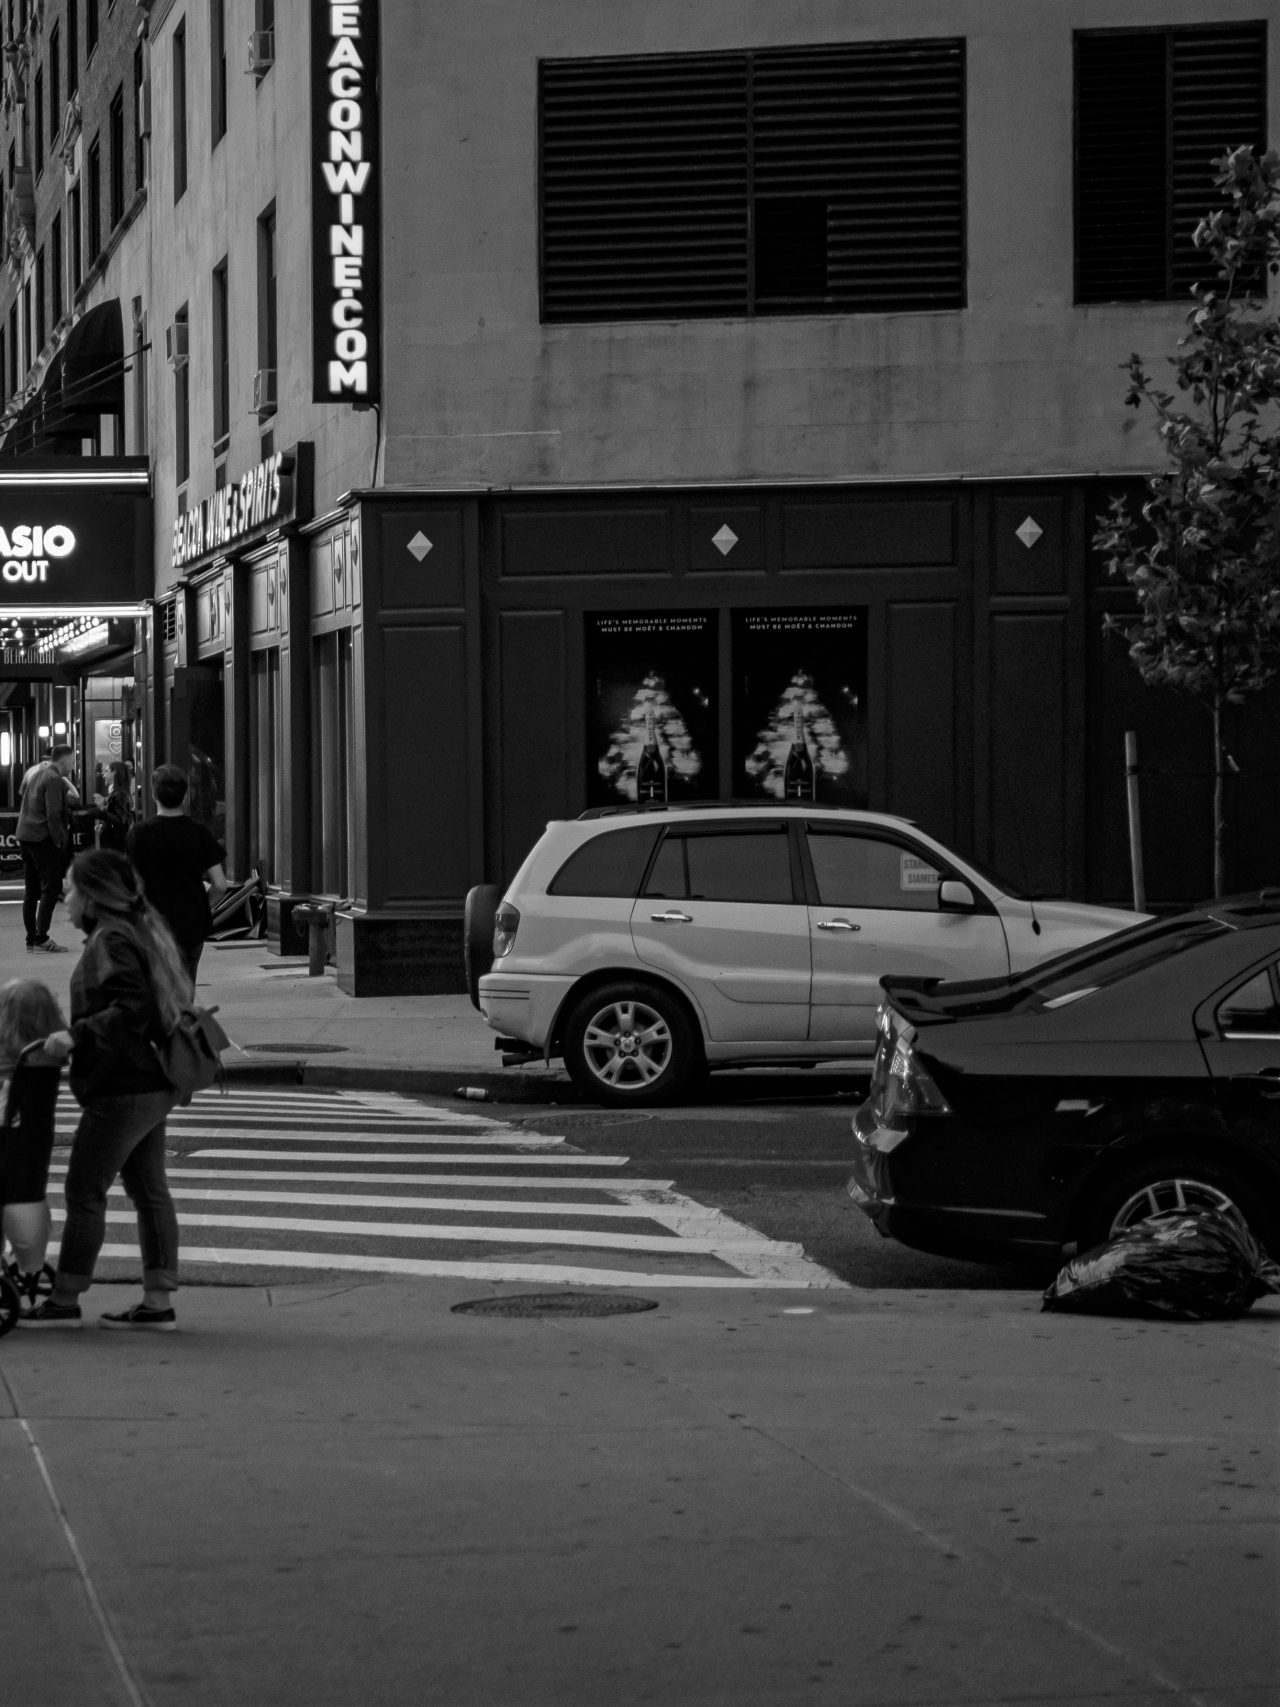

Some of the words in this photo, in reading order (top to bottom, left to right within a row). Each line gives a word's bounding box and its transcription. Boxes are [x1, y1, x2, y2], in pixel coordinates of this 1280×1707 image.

[322, 0, 372, 394] EACONWINE.COM
[239, 451, 283, 535] SPIRITS
[2, 560, 49, 581] OUT
[621, 617, 667, 625] MEMORABLE
[819, 614, 858, 622] MOMENTS
